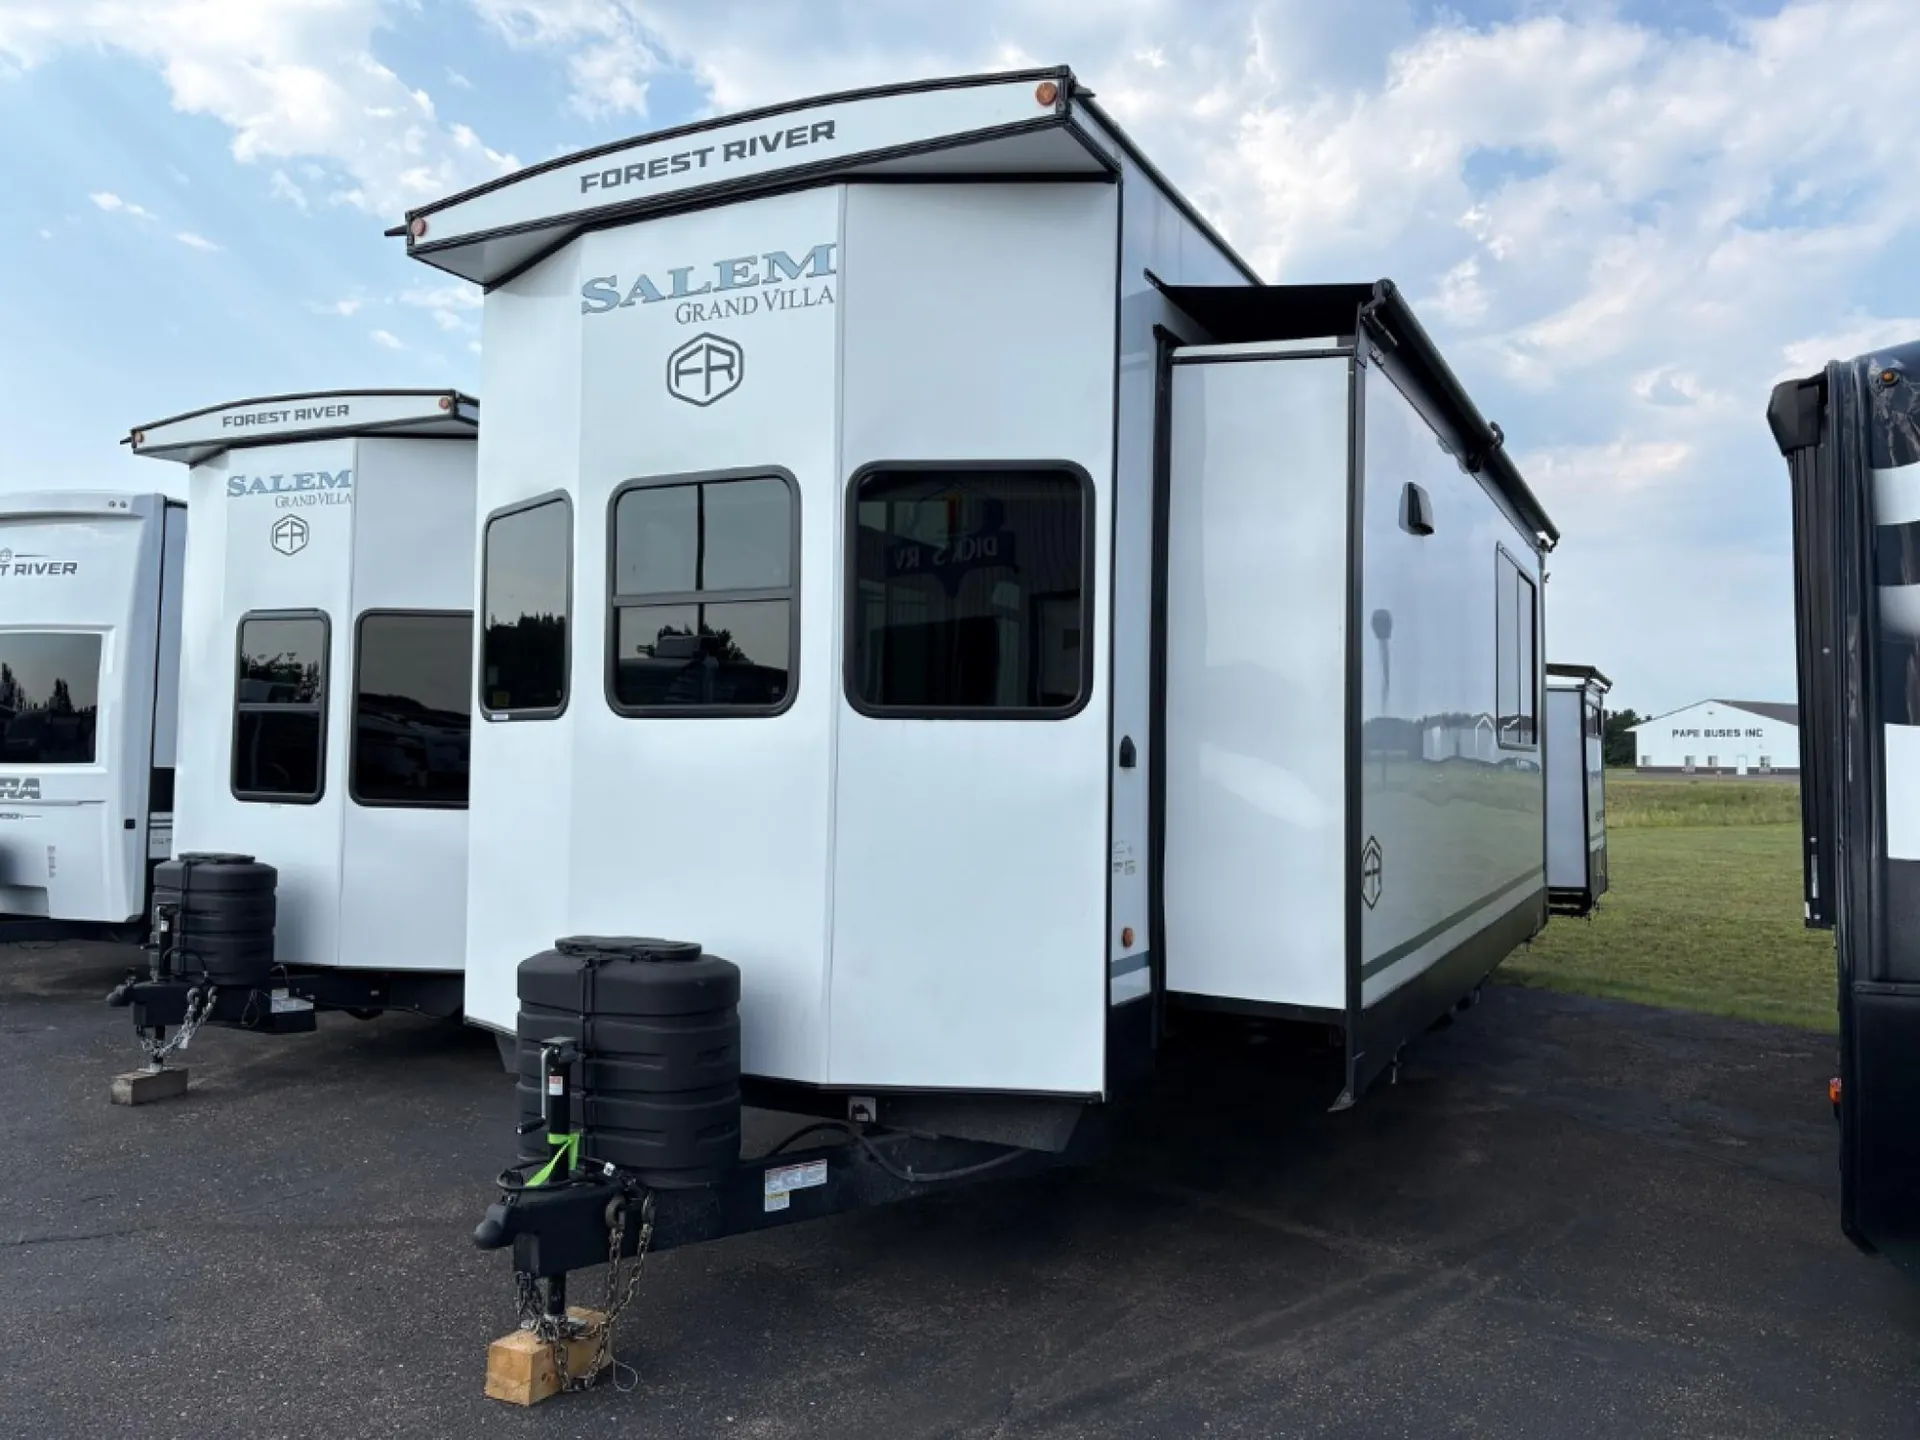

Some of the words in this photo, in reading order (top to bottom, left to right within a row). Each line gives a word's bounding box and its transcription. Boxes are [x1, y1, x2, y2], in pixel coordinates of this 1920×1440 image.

[580, 146, 715, 194] FOREST
[722, 119, 836, 163] RIVER
[581, 243, 837, 315] SALEM
[675, 295, 759, 325] GRAND
[762, 284, 836, 312] VILLA
[222, 410, 291, 428] FOREST
[295, 404, 350, 421] RIVER
[227, 469, 352, 498] SALEM
[275, 494, 317, 509] GRAND
[317, 491, 353, 506] VILLA
[14, 562, 78, 577] RIVER
[1672, 728, 1700, 738] PAPE
[1704, 728, 1741, 738] BUSES
[1744, 728, 1764, 738] INC
